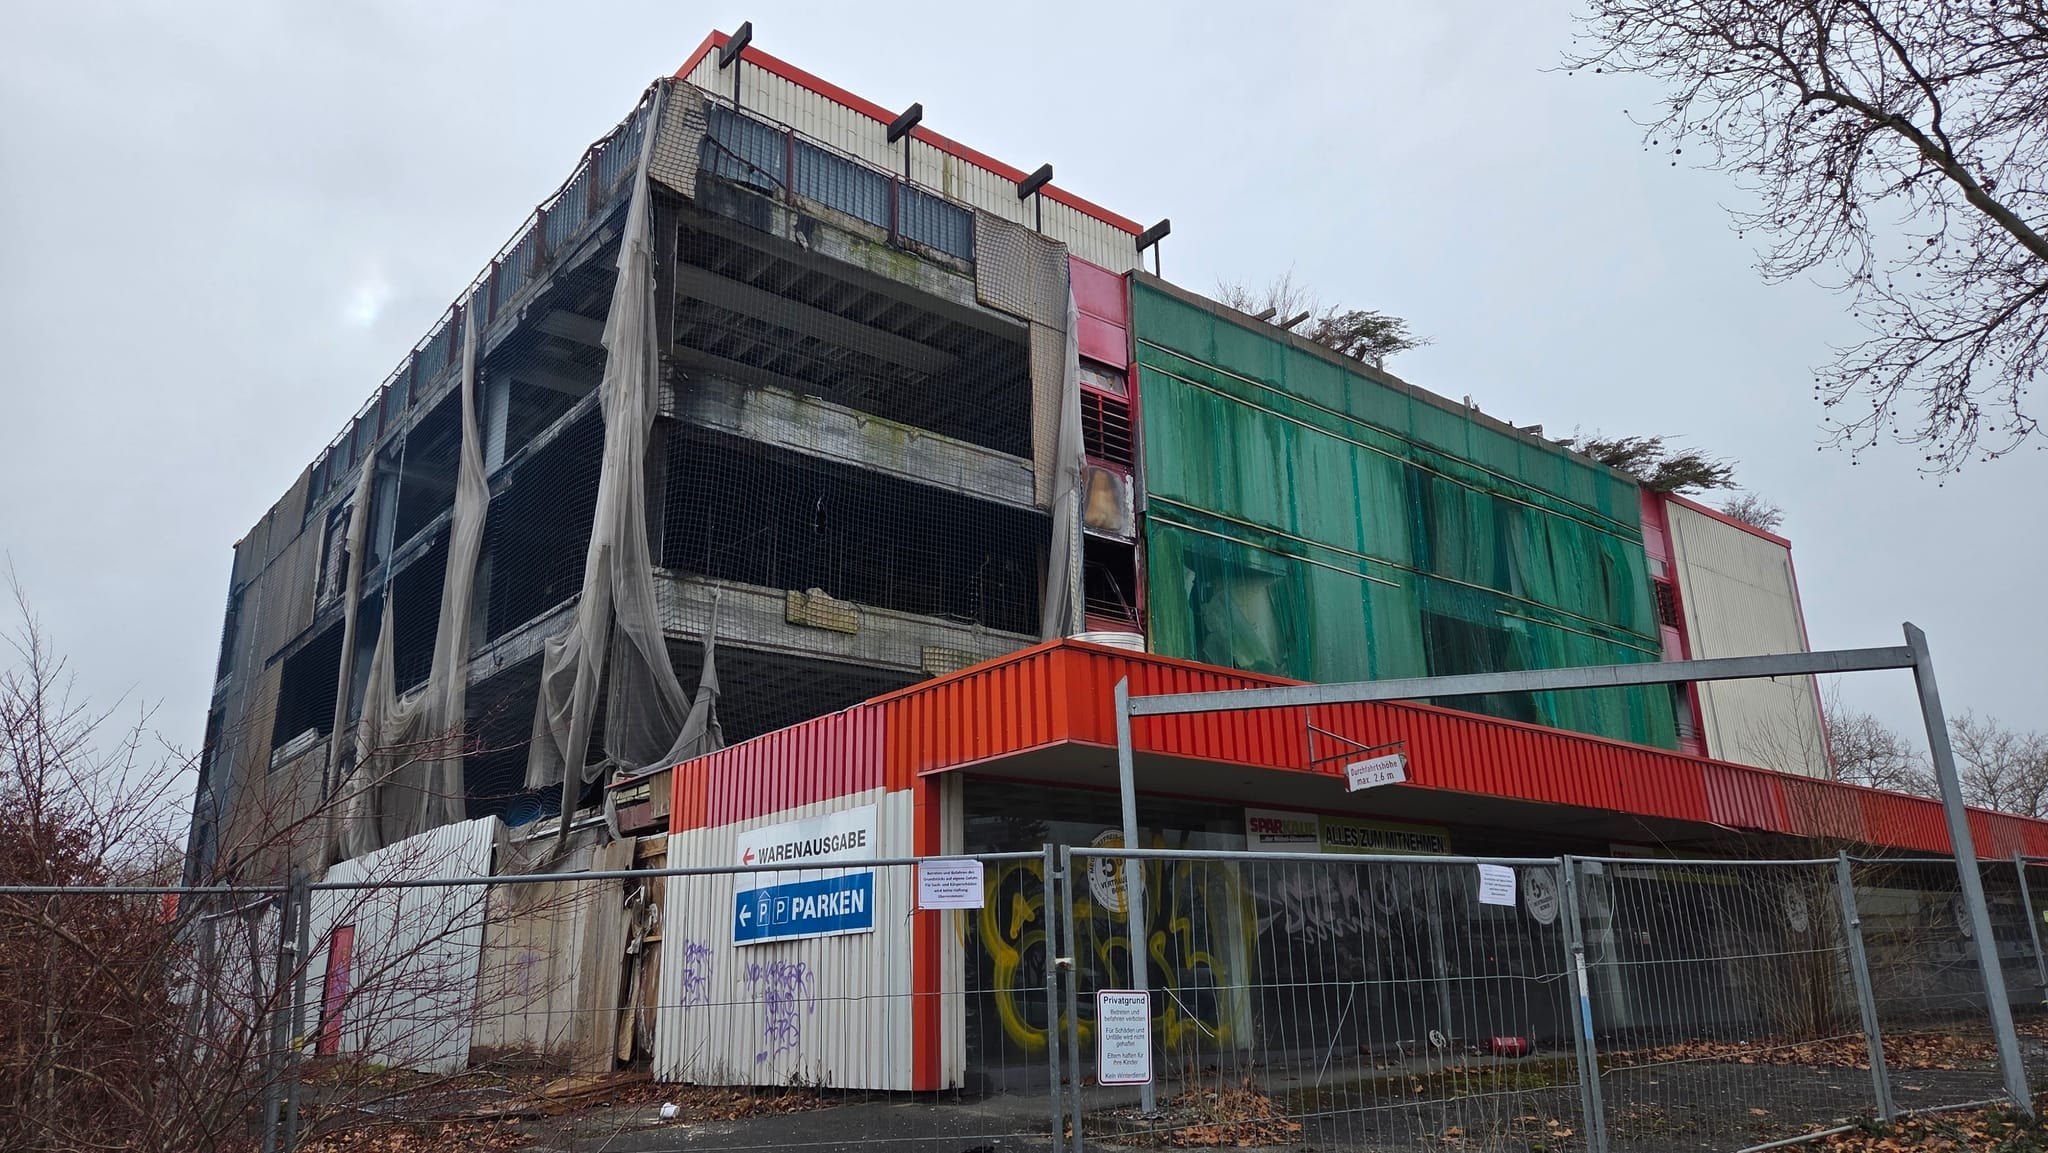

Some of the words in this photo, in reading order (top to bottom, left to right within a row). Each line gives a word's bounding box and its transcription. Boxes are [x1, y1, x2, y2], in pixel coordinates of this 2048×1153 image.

[1350, 760, 1398, 777] Durchfahrtshöhe
[1386, 771, 1395, 780] m
[758, 829, 866, 864] WARENAUSGABE
[1326, 824, 1358, 847] ALLES
[1359, 828, 1384, 850] ZUM
[791, 888, 865, 921] PARKEN
[1103, 996, 1145, 1006] Privatgrund
